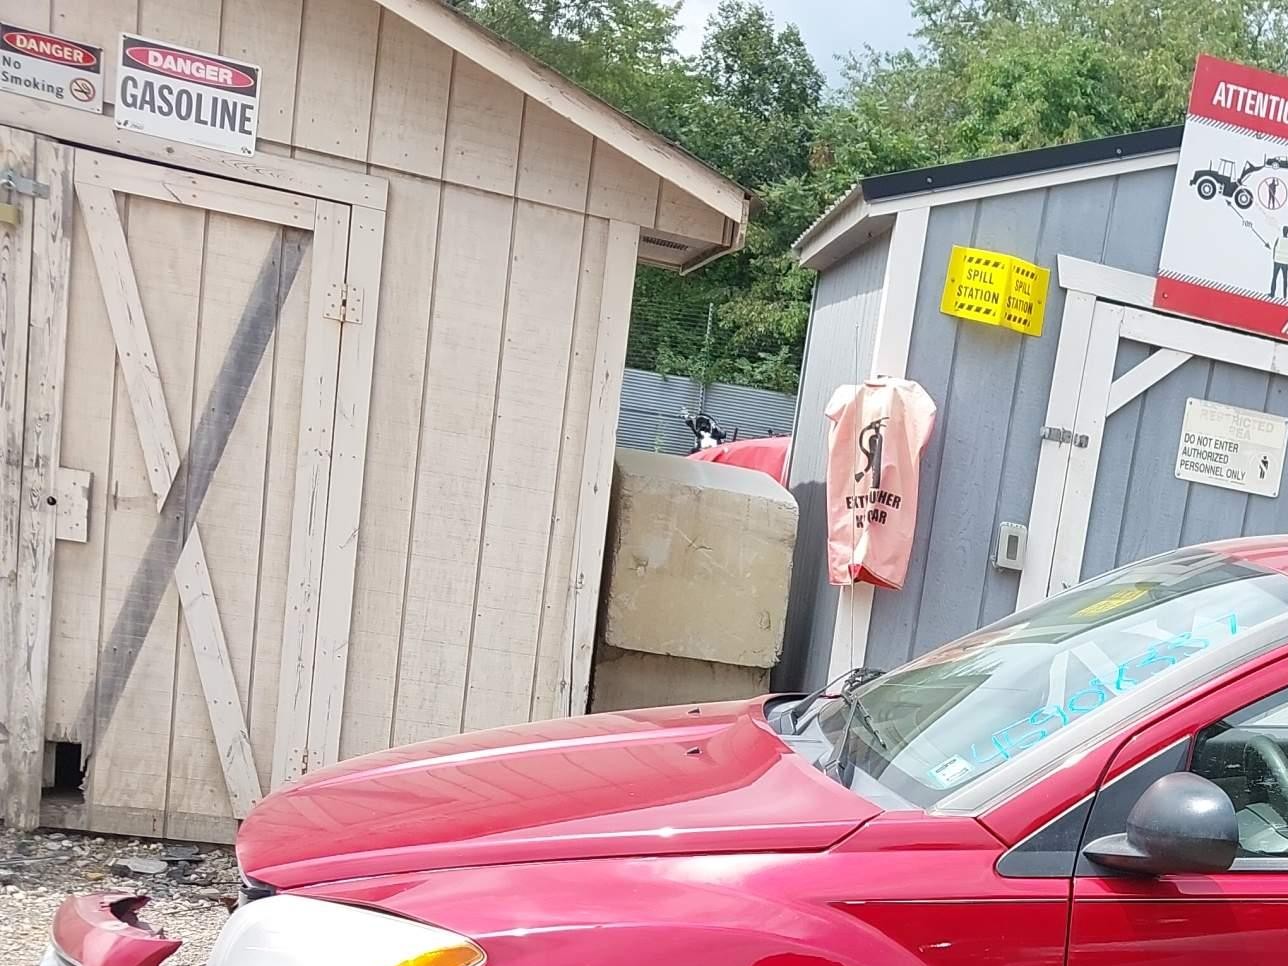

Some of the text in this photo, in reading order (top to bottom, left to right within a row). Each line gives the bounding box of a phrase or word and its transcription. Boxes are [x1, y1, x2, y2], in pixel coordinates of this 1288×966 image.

[15, 34, 84, 64] DANGER
[2, 55, 21, 70] No
[148, 51, 233, 85] DANGER
[1, 71, 65, 99] Smoking
[121, 75, 254, 135] GASOLINE
[967, 268, 994, 285] SPILL
[957, 284, 999, 305] STATION
[1015, 279, 1031, 296] SPILL
[1007, 295, 1034, 315] STATION
[1184, 432, 1239, 454] DO NOT ENTER
[1182, 446, 1229, 465] AUTHORIZED
[1180, 459, 1225, 478] PERSONNEL
[1226, 468, 1246, 481] ONLY
